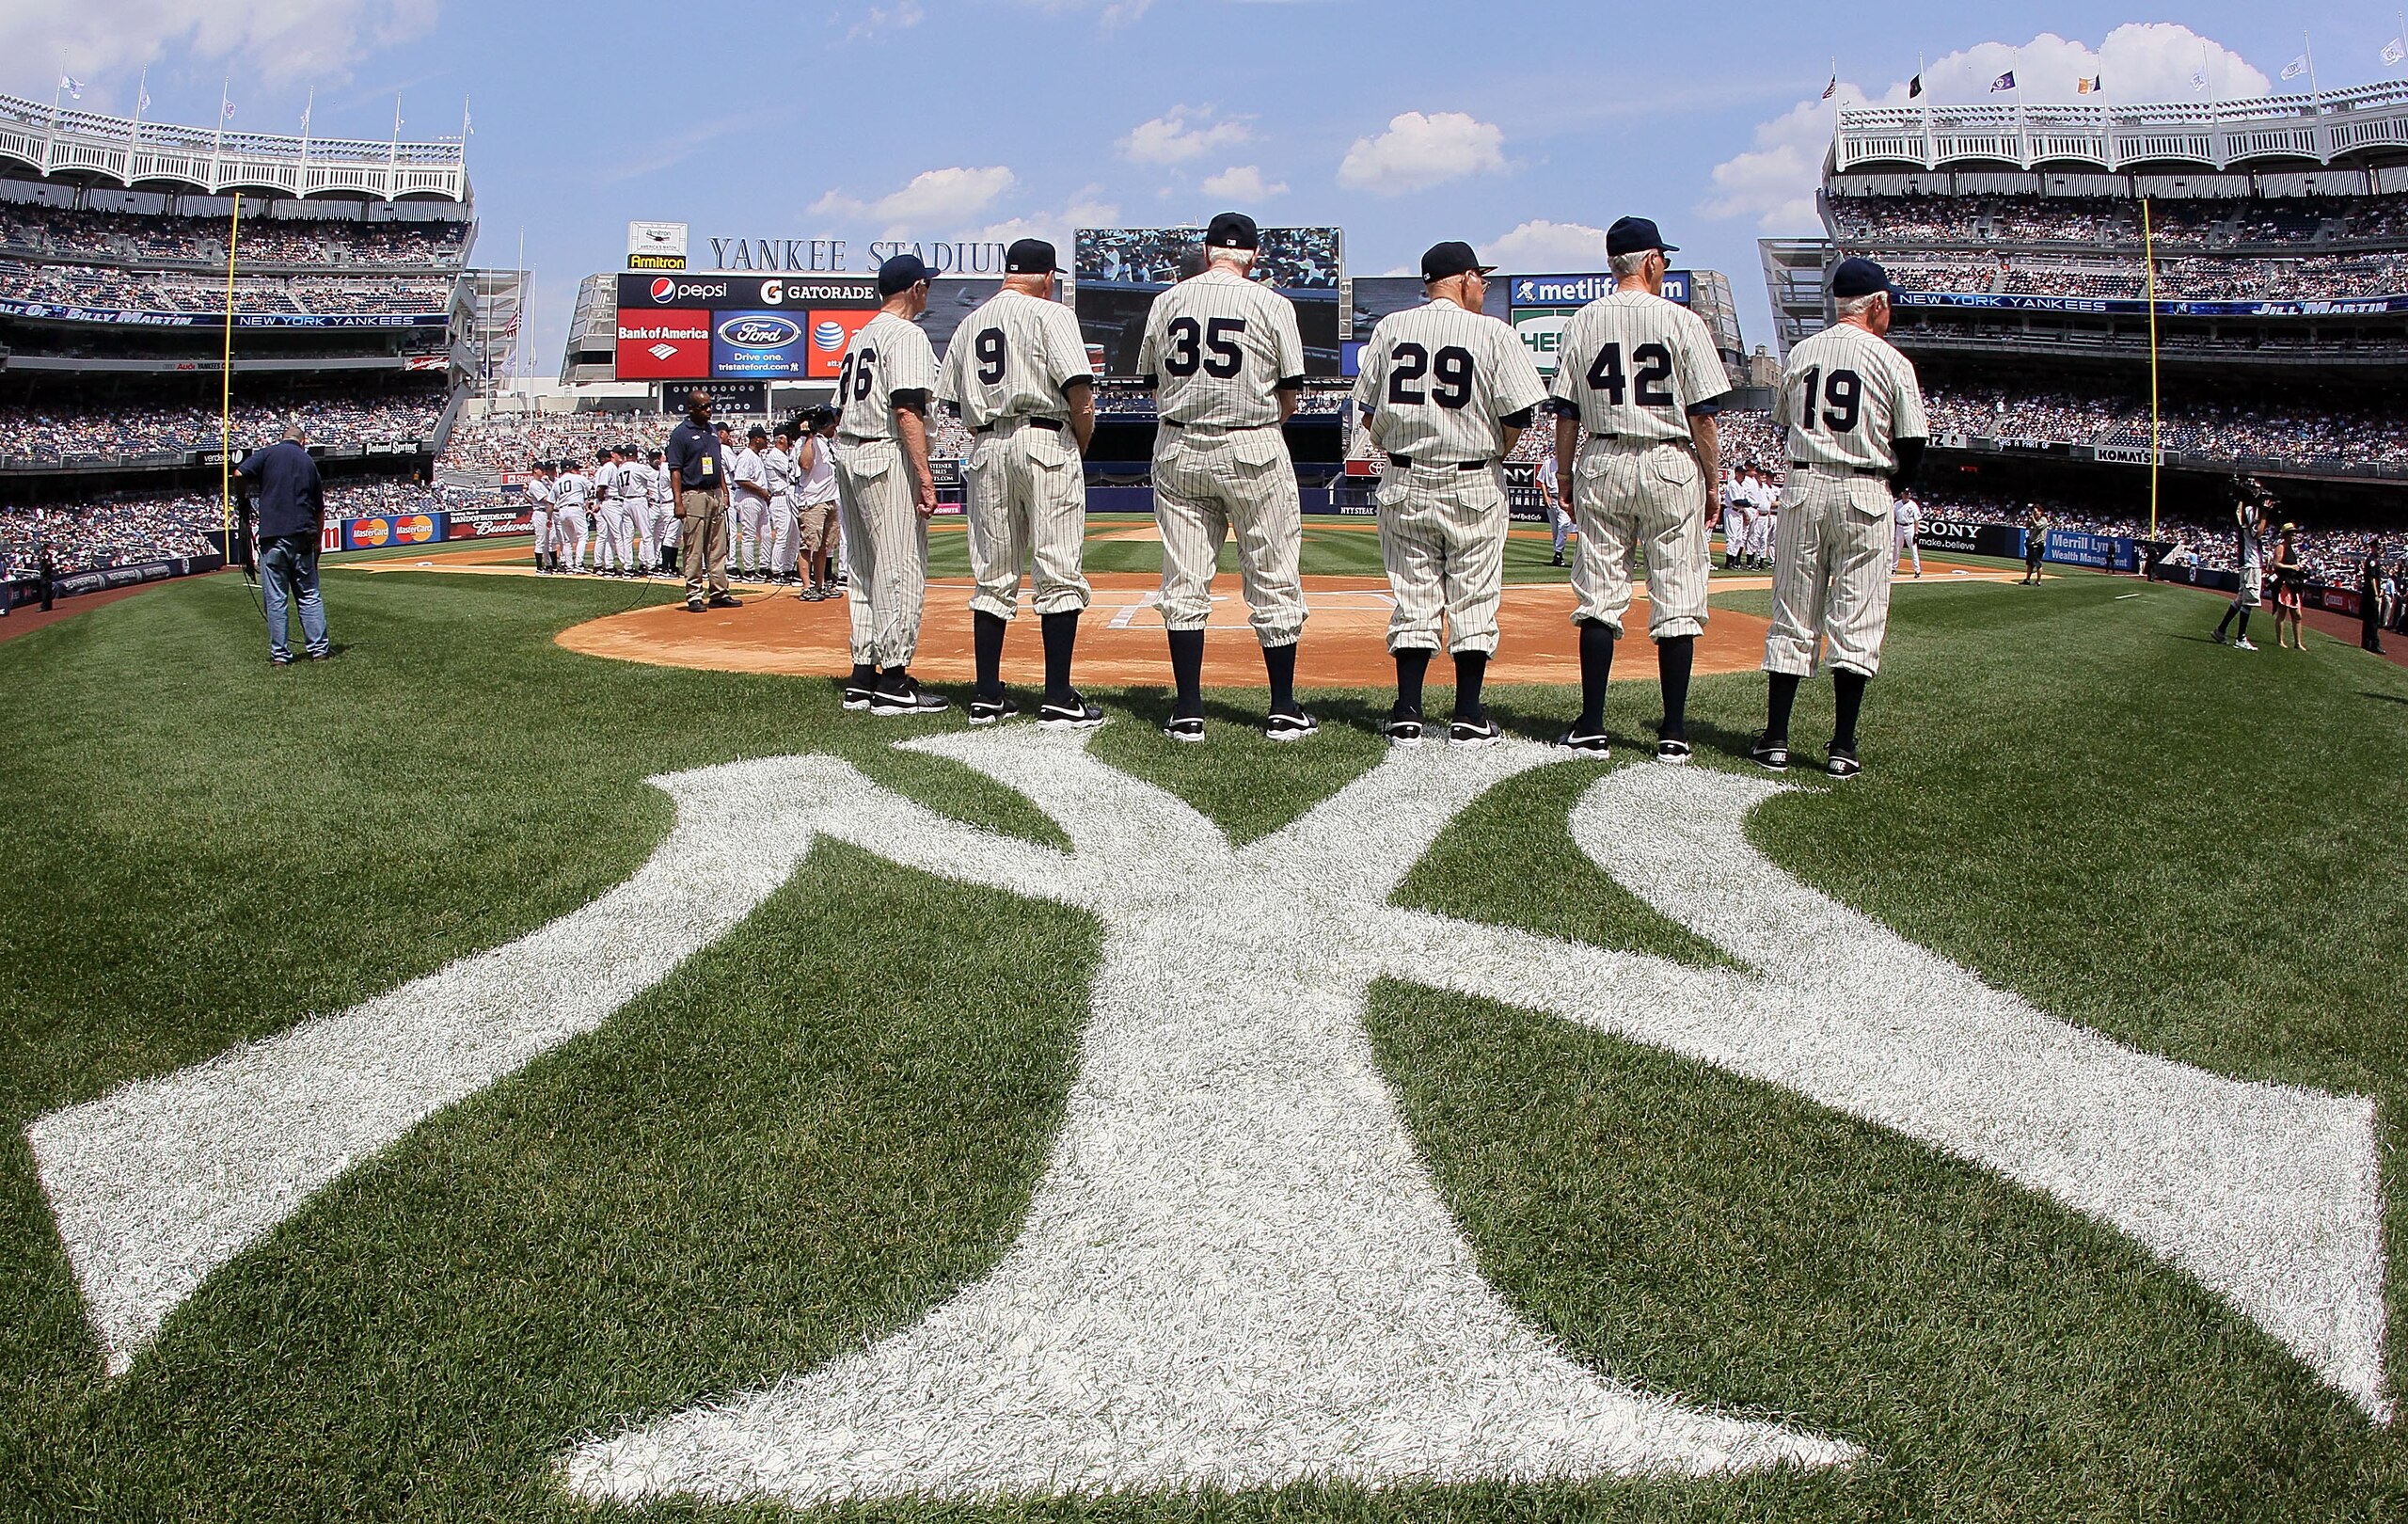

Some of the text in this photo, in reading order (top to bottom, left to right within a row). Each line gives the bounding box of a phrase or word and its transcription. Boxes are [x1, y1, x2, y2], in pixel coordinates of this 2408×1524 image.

[630, 255, 685, 269] Armitron
[707, 237, 847, 272] YANKEE
[677, 282, 727, 300] pepsi
[787, 285, 875, 301] GATORADE
[1539, 278, 1683, 301] metlifm
[0, 303, 24, 314] ALF
[1899, 294, 2107, 311] NEW YORK YANKEES
[239, 316, 415, 325] NEW YORK YANKEES
[618, 326, 647, 340] Bank
[660, 327, 708, 340] America
[737, 321, 782, 343] Ford
[1164, 316, 1245, 379] 35
[734, 353, 760, 361] Drive
[974, 326, 1007, 386] 9
[719, 363, 789, 372] tristateford.com
[1387, 341, 1474, 409] 29
[1586, 341, 1674, 406] 42
[1802, 366, 1862, 434] 19
[366, 441, 419, 455] Poland Spring
[2022, 439, 2038, 449] PART
[619, 470, 631, 487] 17
[1503, 468, 1534, 483] NY
[559, 480, 572, 495] 10
[450, 513, 516, 523] BANDOFBUDS.COM
[353, 528, 388, 538] MasterCard
[396, 523, 433, 536] MasterCard
[472, 520, 534, 535] Budwei
[1918, 520, 1982, 538] SONY
[1918, 537, 1975, 551] make.believe
[2052, 533, 2088, 549] Merrill
[2091, 538, 2121, 553] Lynh
[2052, 549, 2078, 562] Wealth
[1768, 752, 1787, 762] NIKE
[1829, 760, 1847, 771] NIKE
